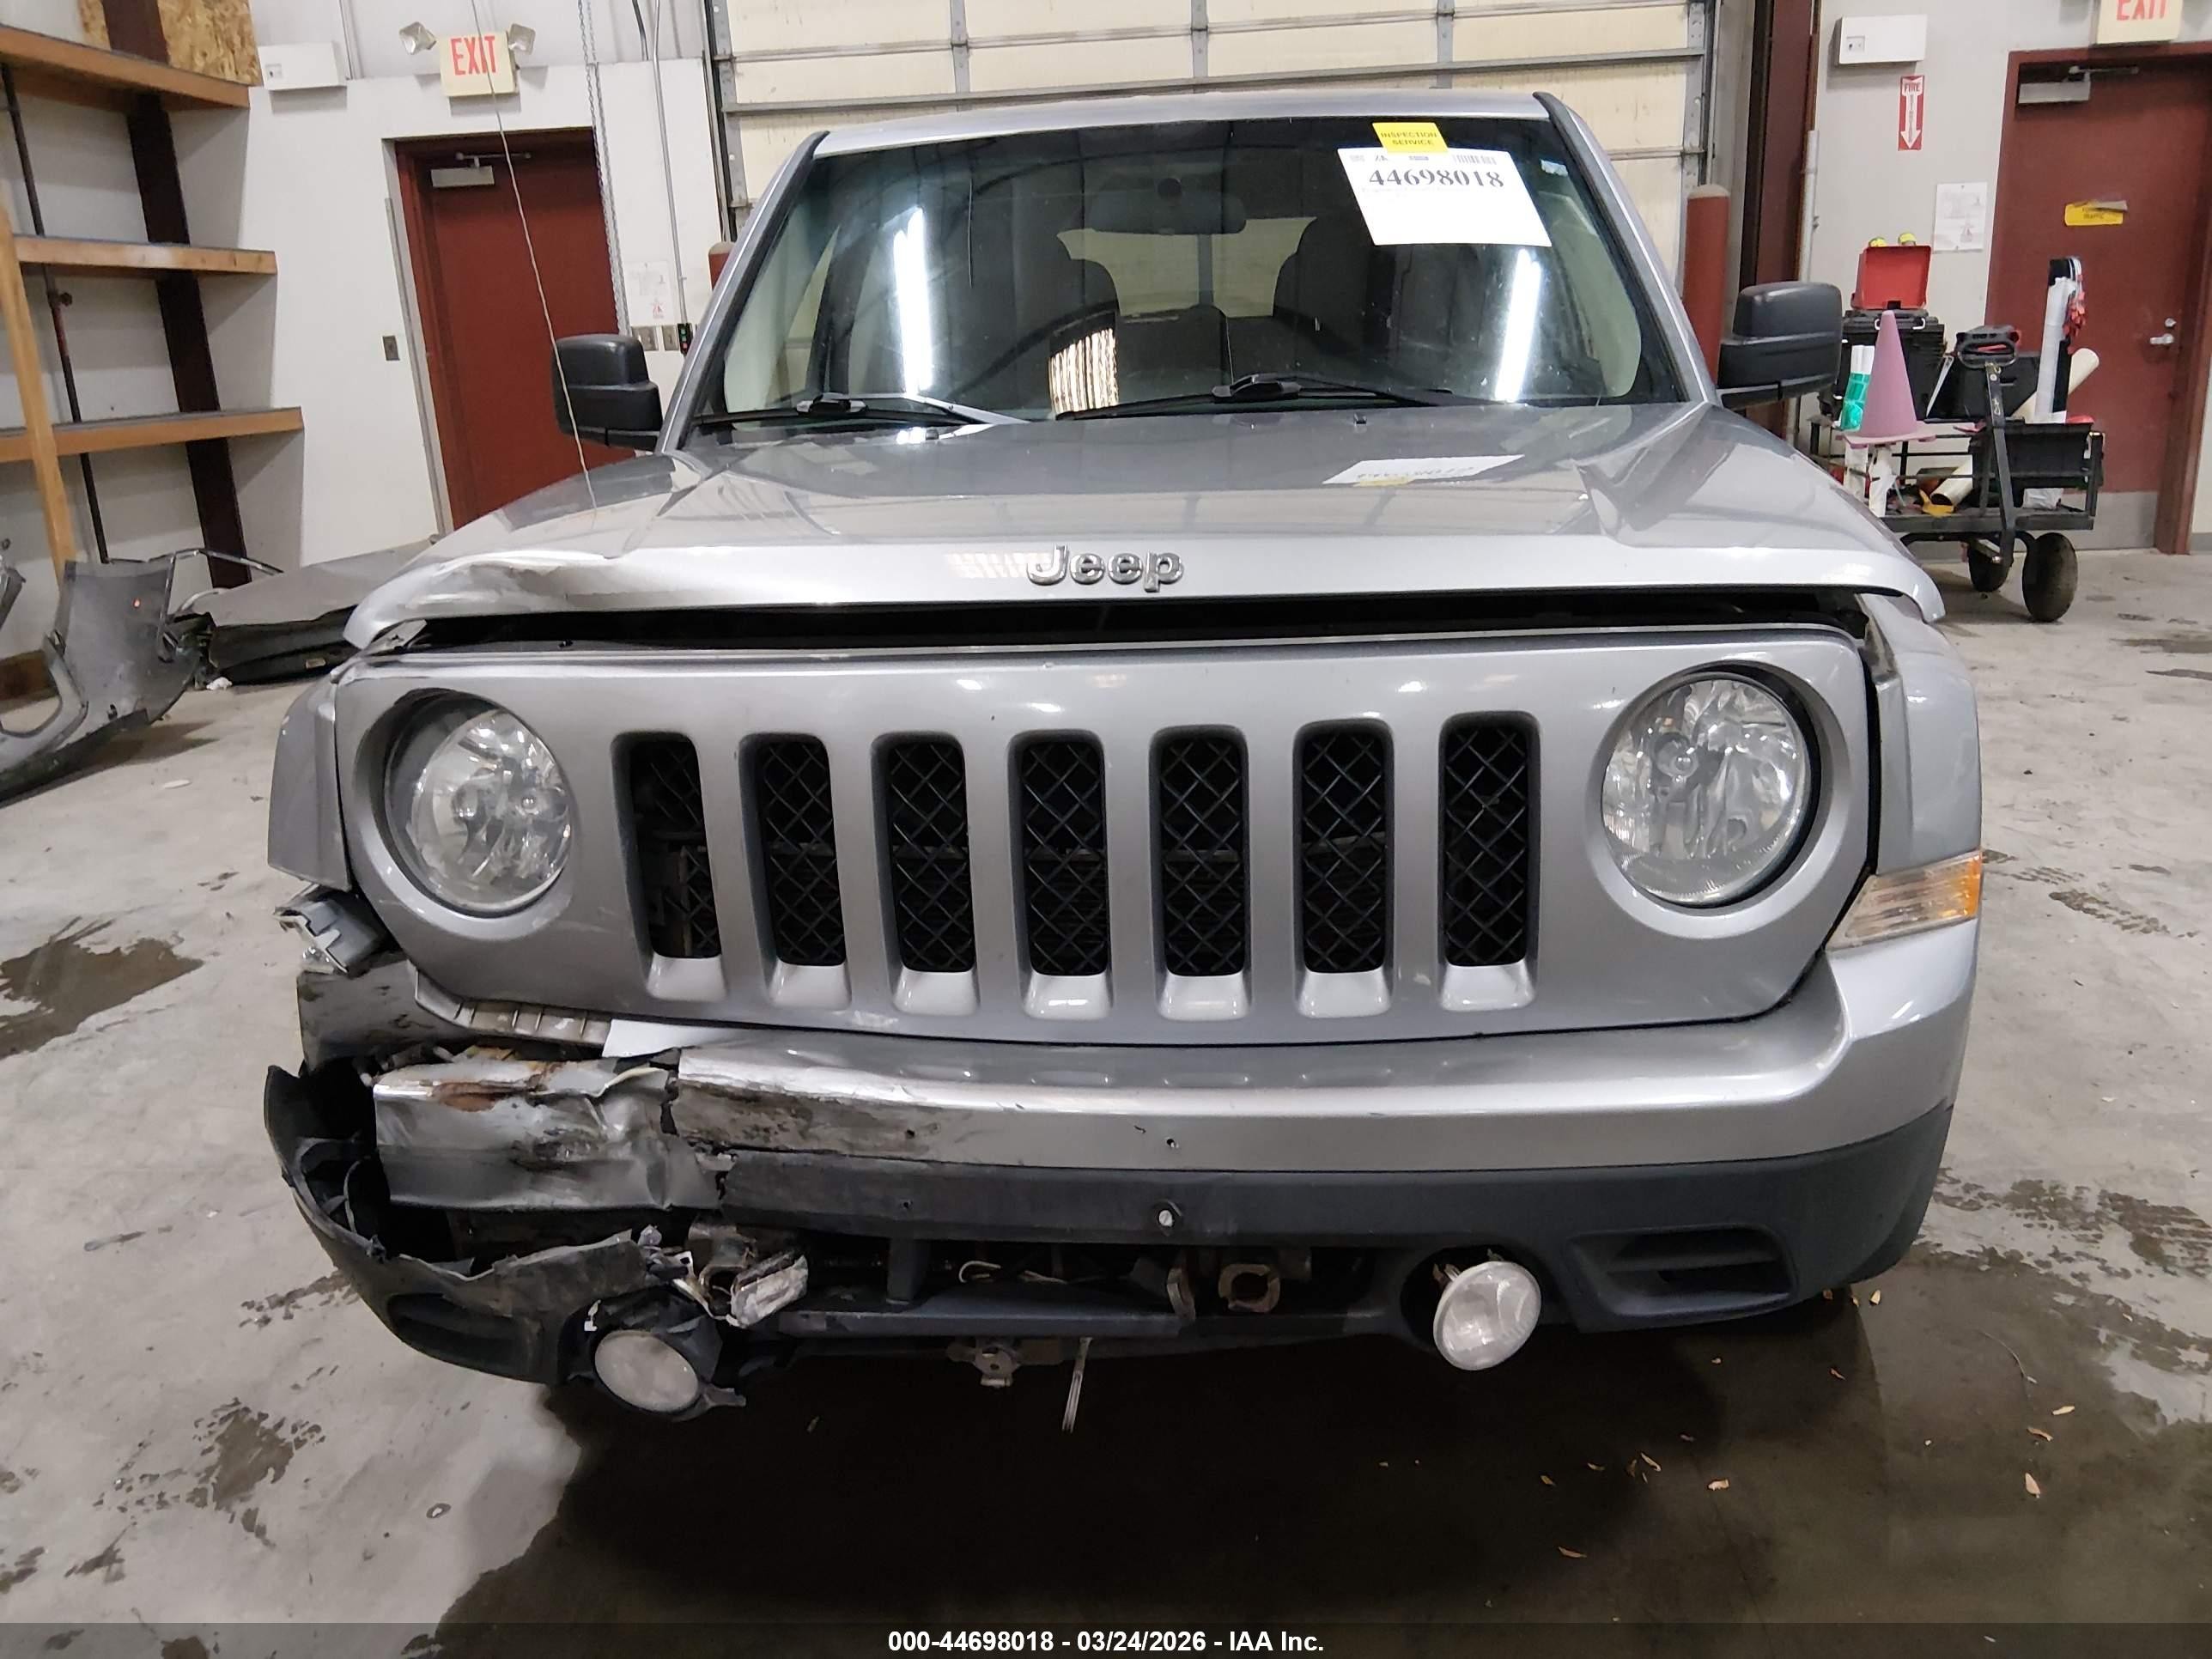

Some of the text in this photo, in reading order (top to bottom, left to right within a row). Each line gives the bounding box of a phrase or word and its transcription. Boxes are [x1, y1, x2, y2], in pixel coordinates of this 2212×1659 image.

[450, 35, 497, 76] EXIT
[1905, 82, 1921, 93] FIRE
[1380, 131, 1438, 139] INSPECTION
[1369, 168, 1504, 188] 44698018
[1025, 542, 1185, 593] Jeep
